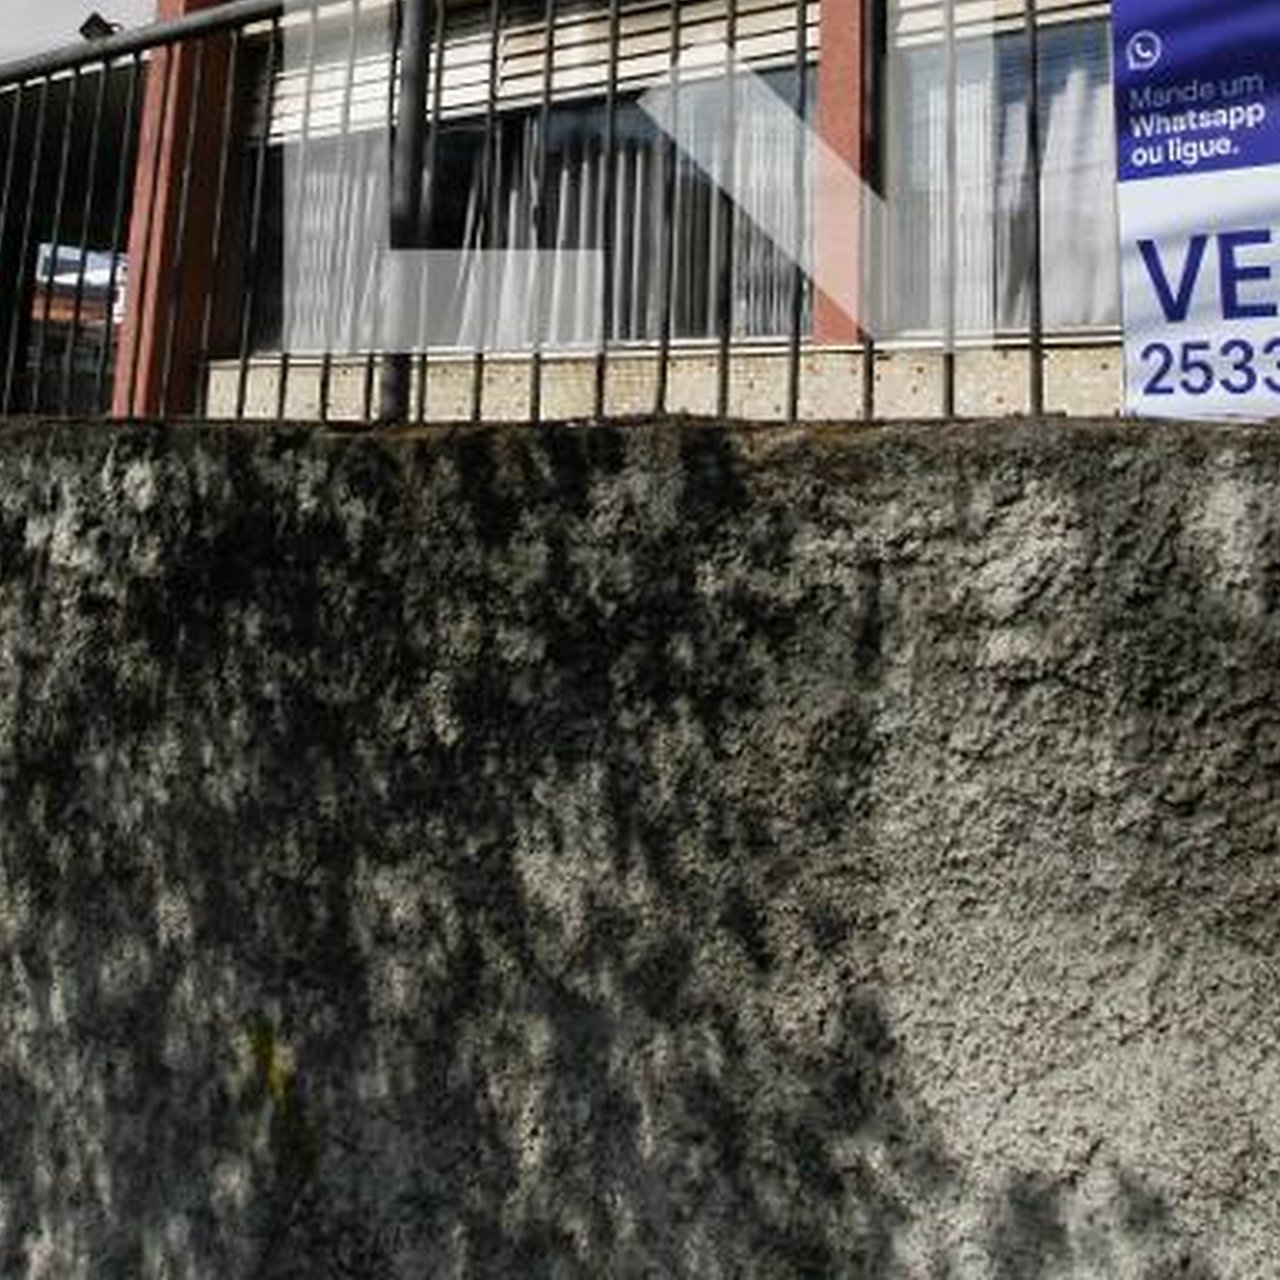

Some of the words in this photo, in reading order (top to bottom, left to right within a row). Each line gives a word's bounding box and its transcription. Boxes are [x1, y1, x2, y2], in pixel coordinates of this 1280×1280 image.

[1130, 80, 1214, 111] Mande
[1220, 73, 1264, 97] um
[1131, 102, 1266, 138] Whatsapp
[1131, 144, 1163, 167] ou
[1168, 134, 1240, 166] ligue.
